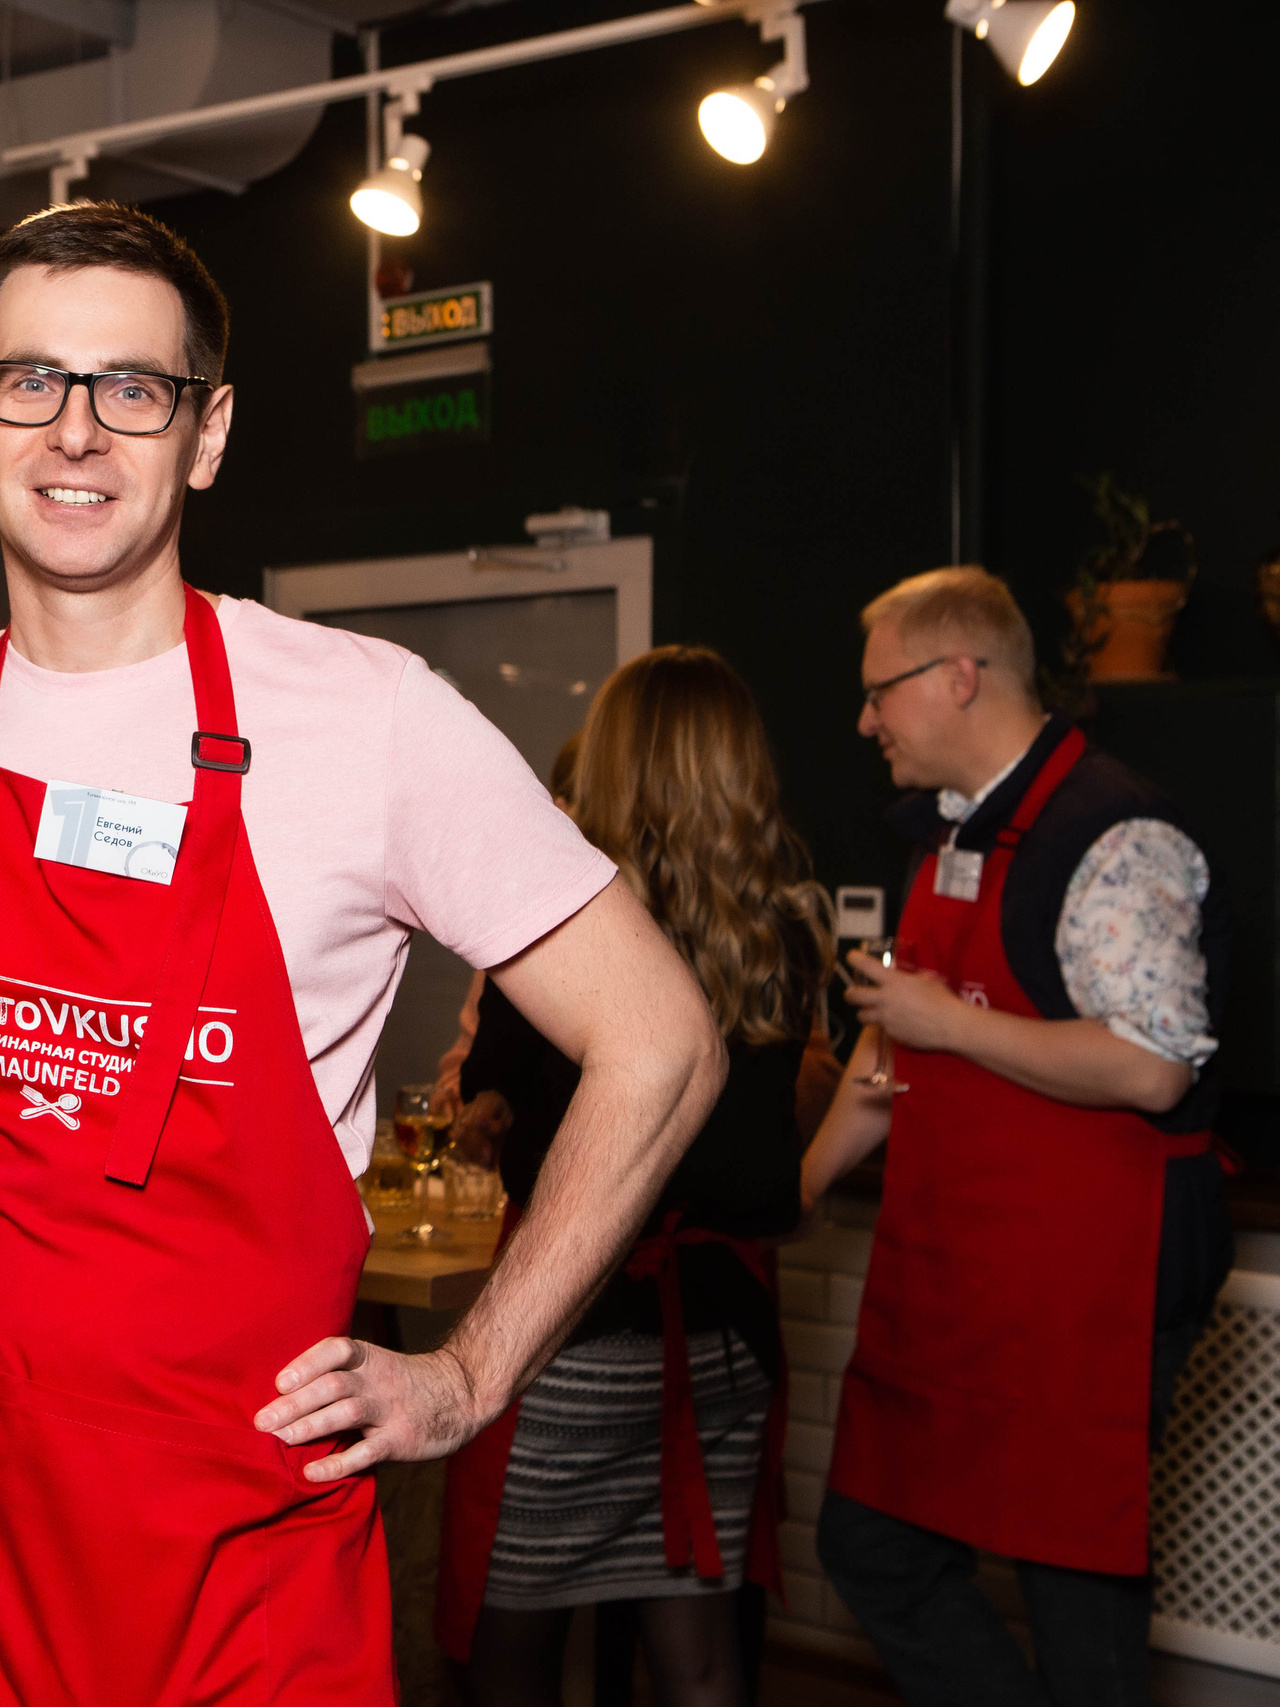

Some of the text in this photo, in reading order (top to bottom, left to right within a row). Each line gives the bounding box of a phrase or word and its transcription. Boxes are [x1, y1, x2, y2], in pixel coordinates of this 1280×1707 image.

[96, 816, 143, 835] Евгений
[93, 830, 133, 848] Седов
[78, 1050, 136, 1074] СТУДИ
